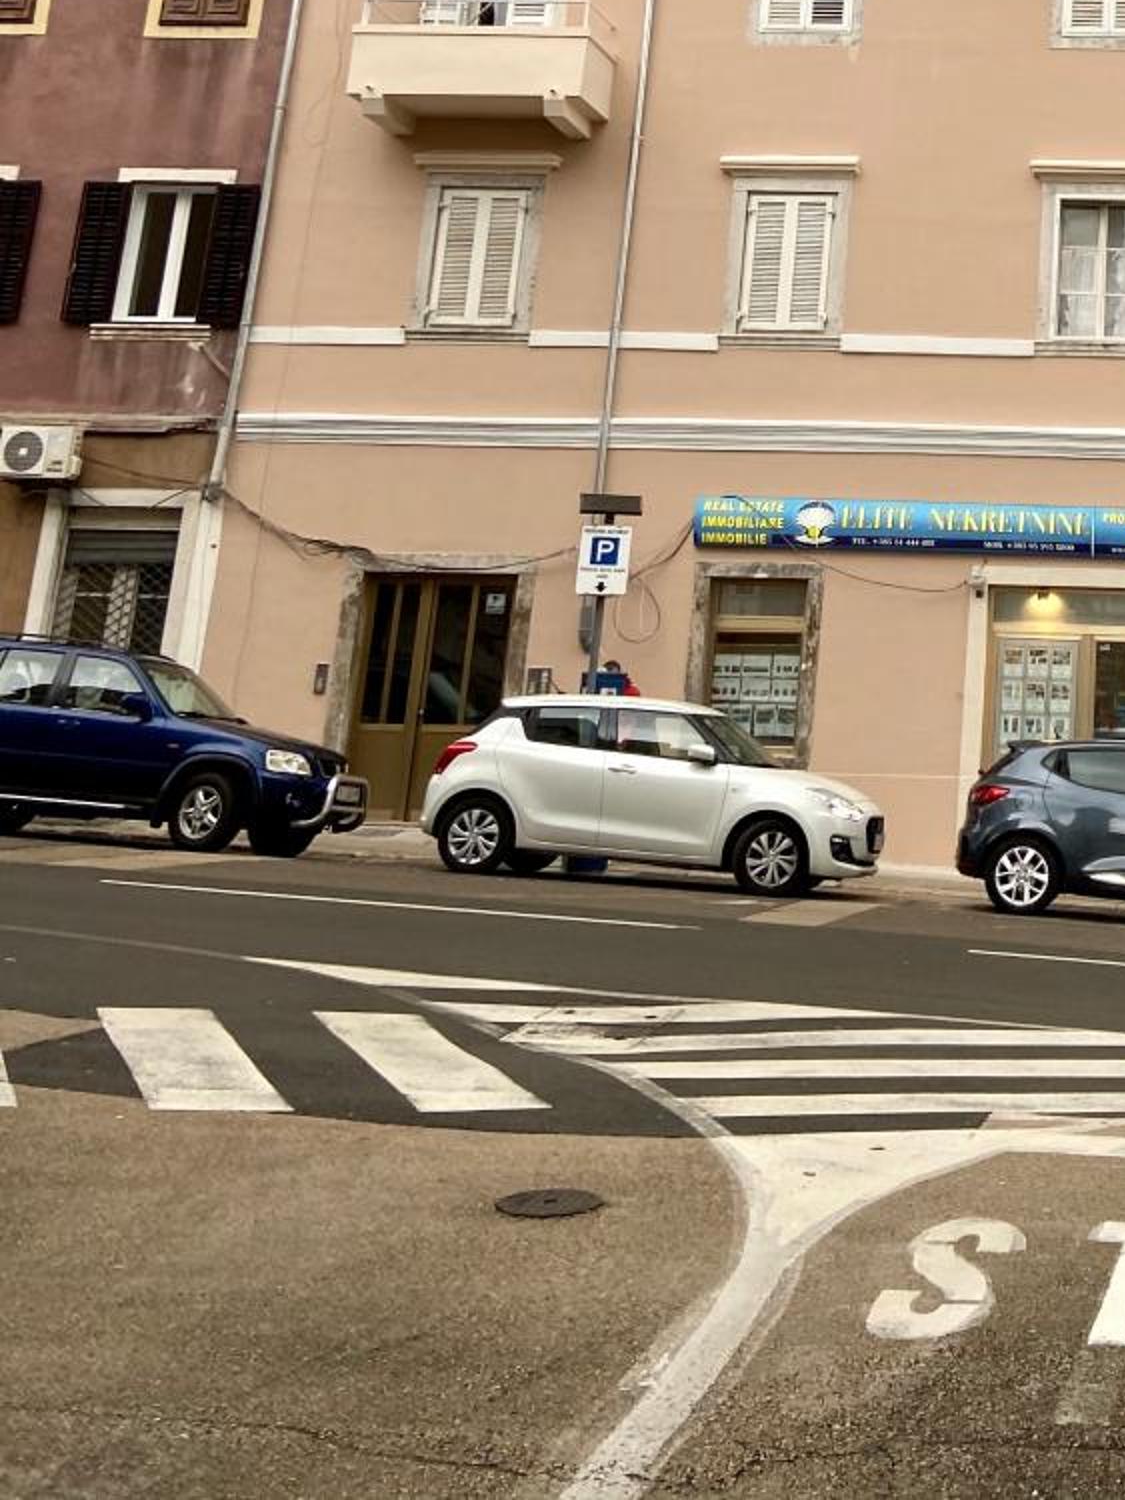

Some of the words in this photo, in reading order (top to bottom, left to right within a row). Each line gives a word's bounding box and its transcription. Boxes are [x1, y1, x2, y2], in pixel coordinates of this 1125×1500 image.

[703, 500, 737, 512] REAL
[740, 501, 785, 513] ESTATE
[702, 515, 785, 529] IMMOBILIARE
[840, 504, 914, 530] ELITE
[928, 507, 1090, 536] NEKRETNINE
[702, 531, 768, 546] IMMOBILIE
[596, 540, 615, 562] P
